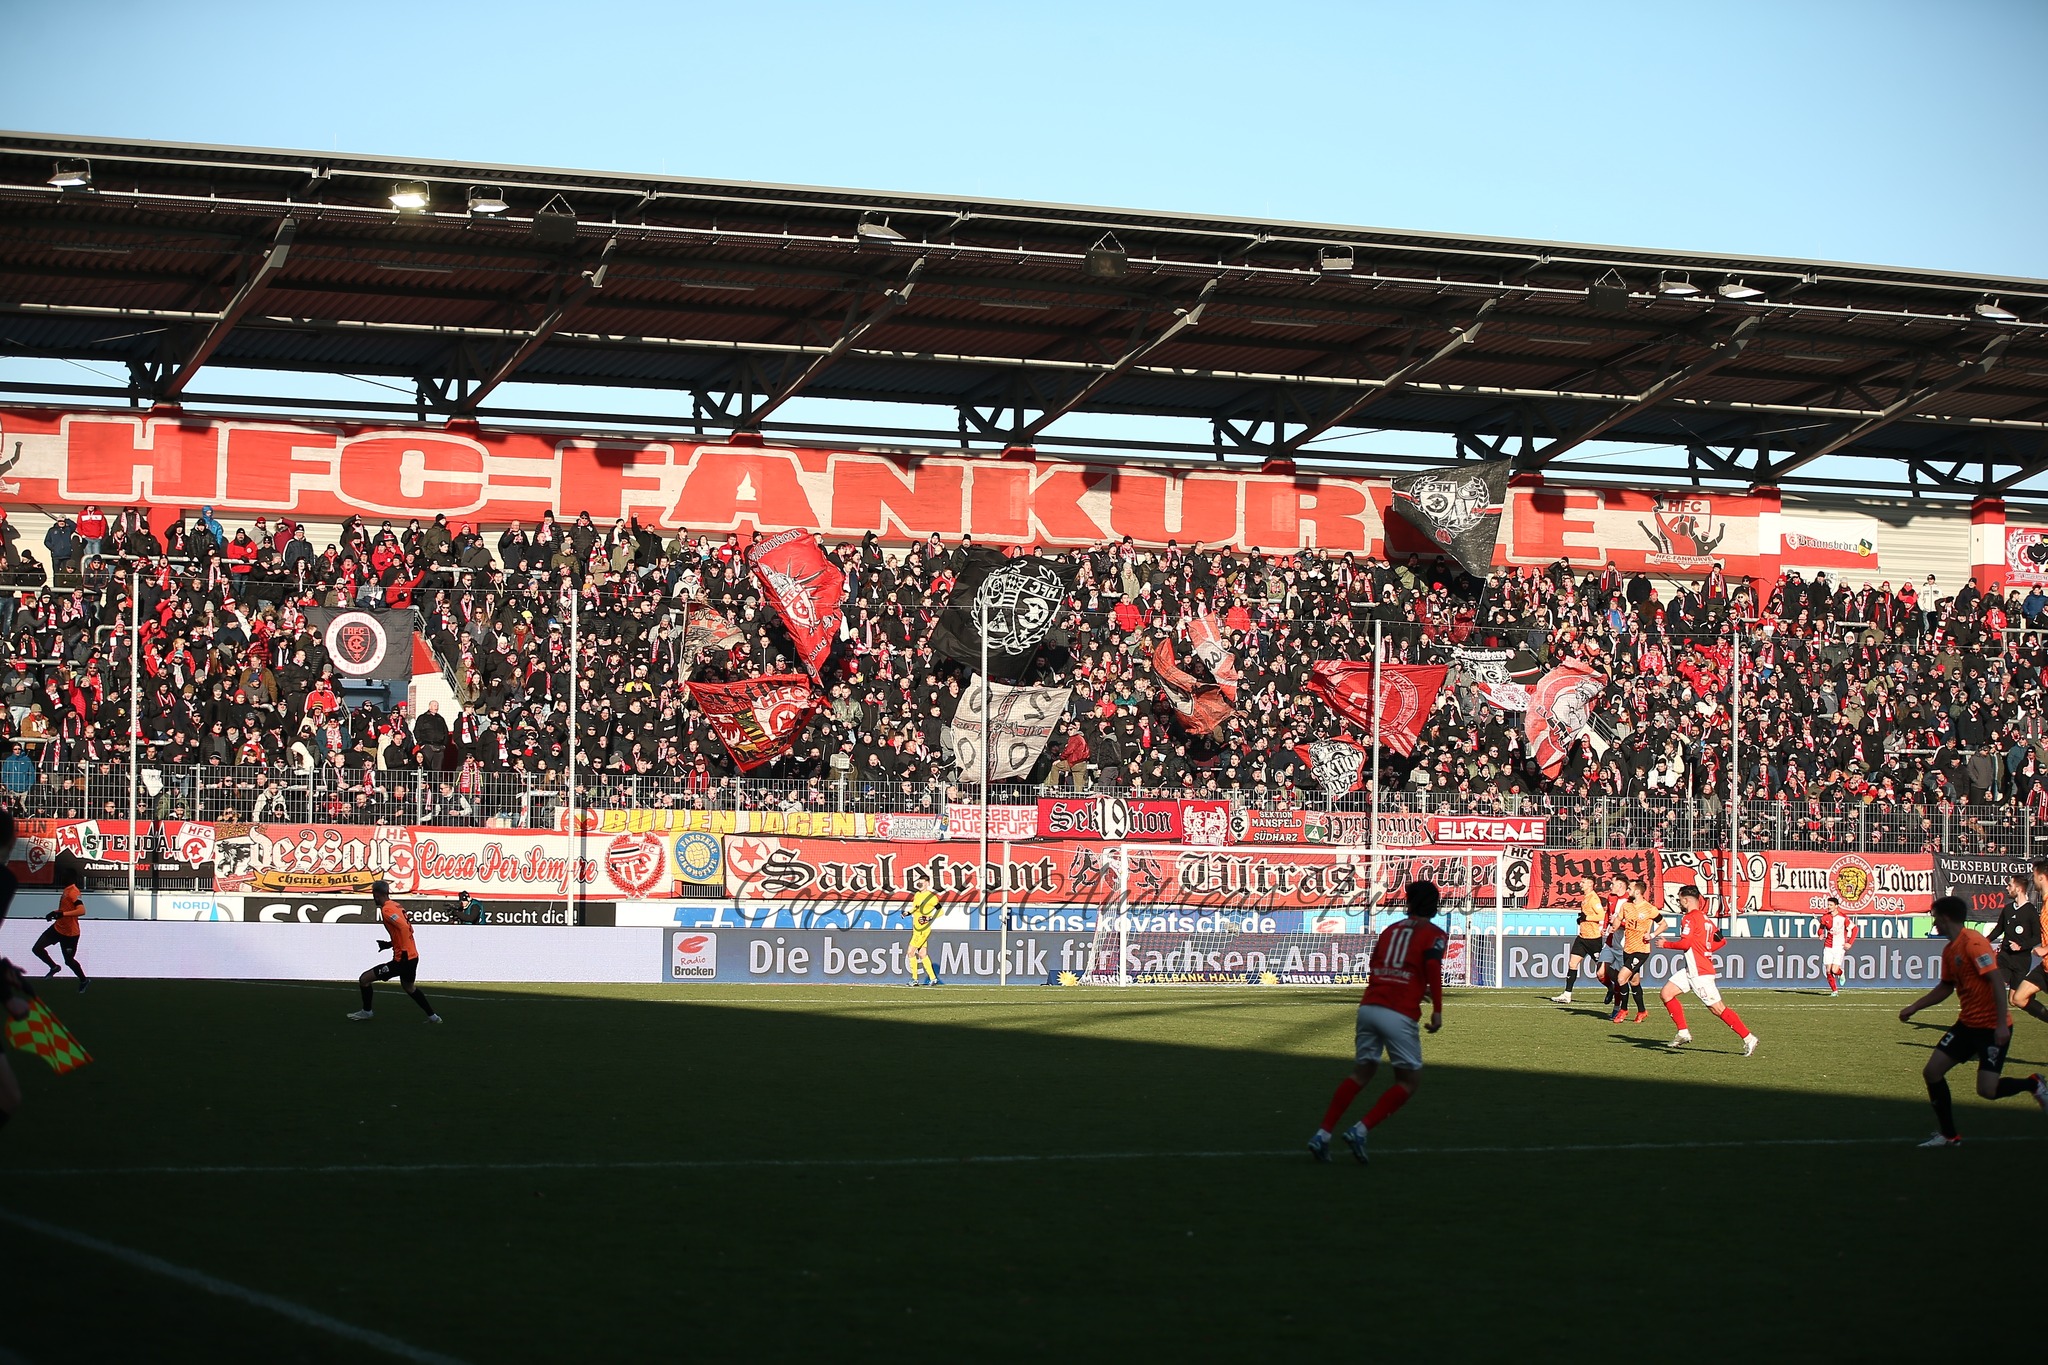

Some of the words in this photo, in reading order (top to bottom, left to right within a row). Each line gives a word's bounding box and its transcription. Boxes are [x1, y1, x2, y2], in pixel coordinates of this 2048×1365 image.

[1668, 500, 1702, 513] HFC
[2017, 535, 2036, 544] HFC
[347, 627, 365, 635] HFC
[761, 684, 811, 708] HFC
[1251, 818, 1302, 828] MANSFELD
[188, 825, 212, 838] HFC
[386, 828, 408, 840] HF
[1253, 830, 1298, 842] SÜDHARZ
[1438, 819, 1545, 842] SURREALE
[33, 836, 50, 848] HFC
[86, 834, 181, 852] STENDAL
[679, 834, 718, 854] FANSZENE
[249, 825, 396, 874] Dessau
[1511, 847, 1533, 860] HFC
[84, 862, 119, 871] Altmark
[153, 863, 180, 871] WEISS
[479, 842, 520, 882] Per
[1663, 852, 1693, 869] HFC
[1831, 856, 1871, 875] HALLESCHER
[1940, 858, 2034, 874] MERSEBURGER
[278, 873, 322, 885] chemie
[327, 875, 359, 885] halle
[762, 848, 1056, 894] Saalefront
[1178, 852, 1356, 896] Ultras
[1774, 862, 1828, 892] Leuna
[1874, 865, 1933, 892] Löwen
[1949, 872, 2012, 886] DOMFALK
[172, 900, 210, 911] NORD
[1810, 896, 1829, 909] sei
[1874, 896, 1905, 911] 1984
[1971, 892, 2006, 911] 1982
[376, 906, 491, 925] Mcedes-z
[495, 909, 538, 925] sucht
[1384, 927, 1413, 968] 10
[681, 955, 706, 966] Radio
[749, 937, 810, 975] Die
[939, 938, 1048, 976] Musik
[674, 965, 715, 977] Brocken
[1137, 974, 1205, 984] SPIELBANK
[1210, 973, 1248, 983] HALLE
[1282, 975, 1332, 984] MERKUR
